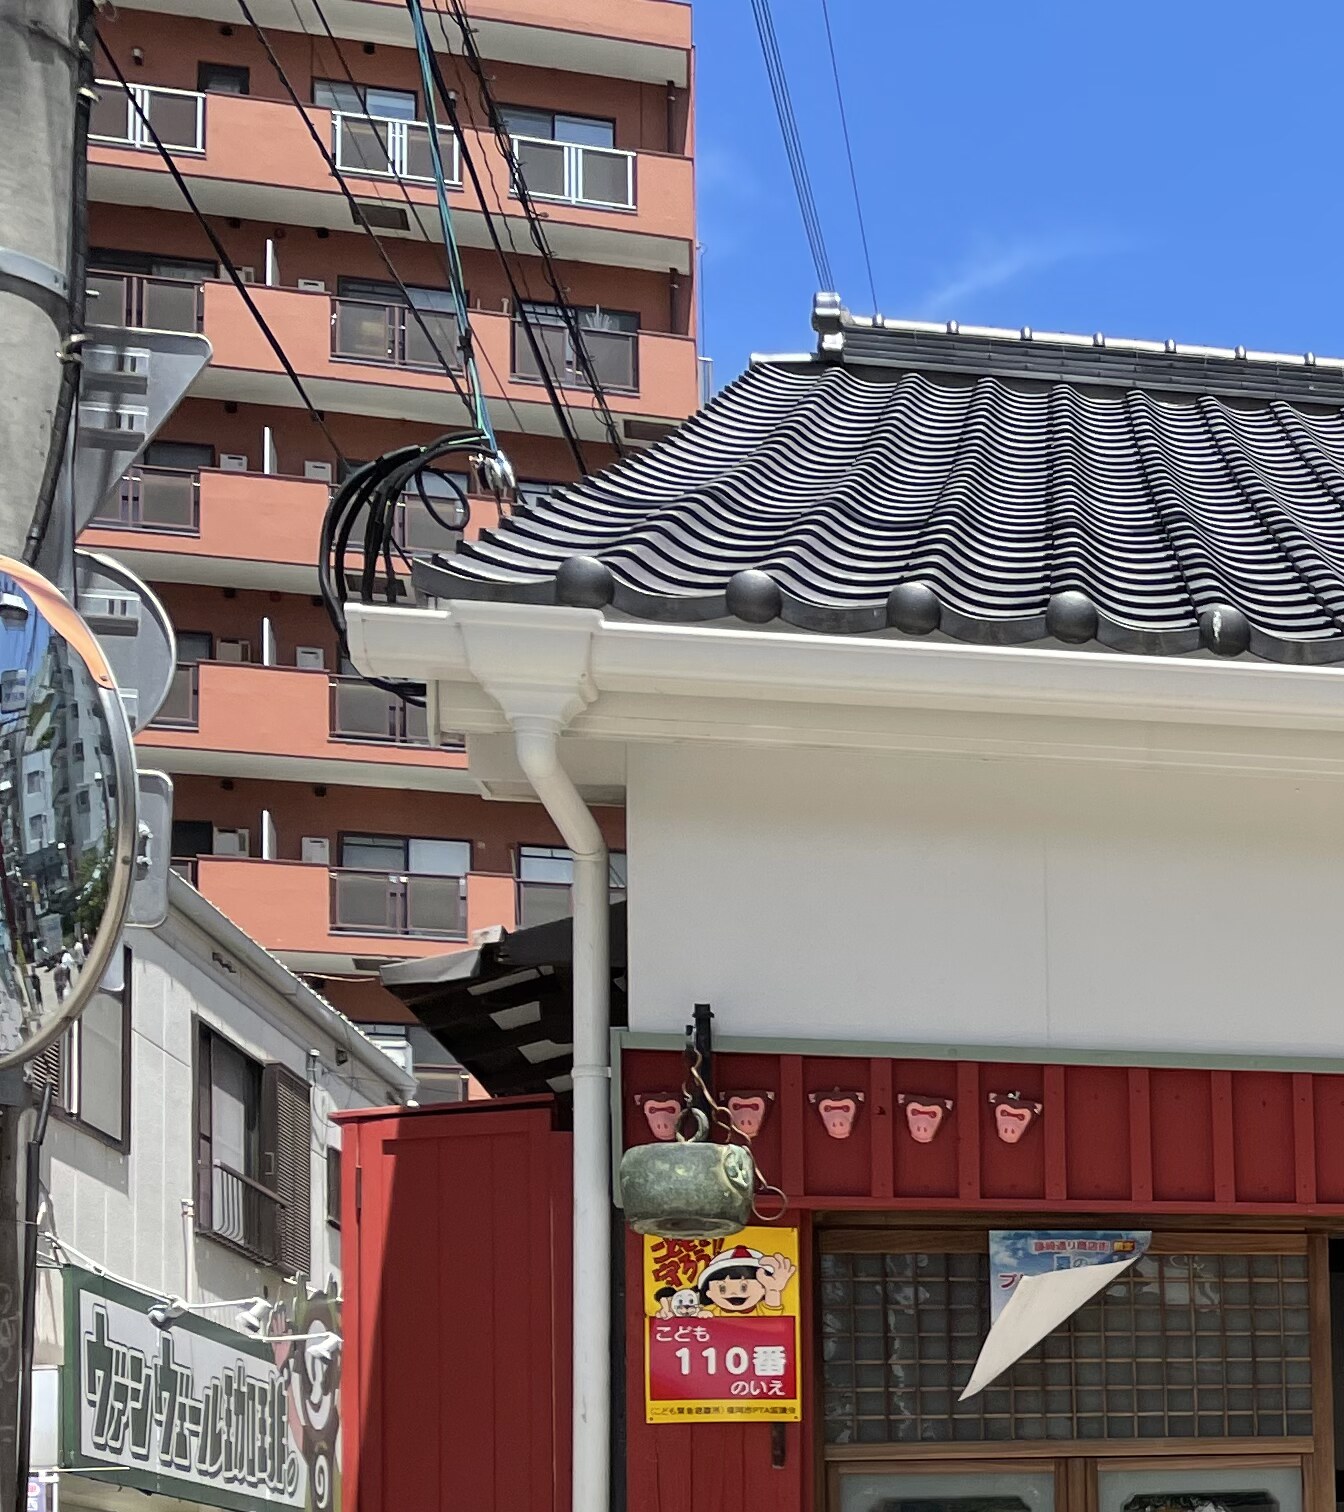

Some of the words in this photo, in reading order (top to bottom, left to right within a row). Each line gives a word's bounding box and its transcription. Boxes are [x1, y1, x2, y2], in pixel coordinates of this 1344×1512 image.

[655, 1326, 710, 1342] こども
[675, 1346, 786, 1377] 110番
[730, 1380, 786, 1396] のいえ
